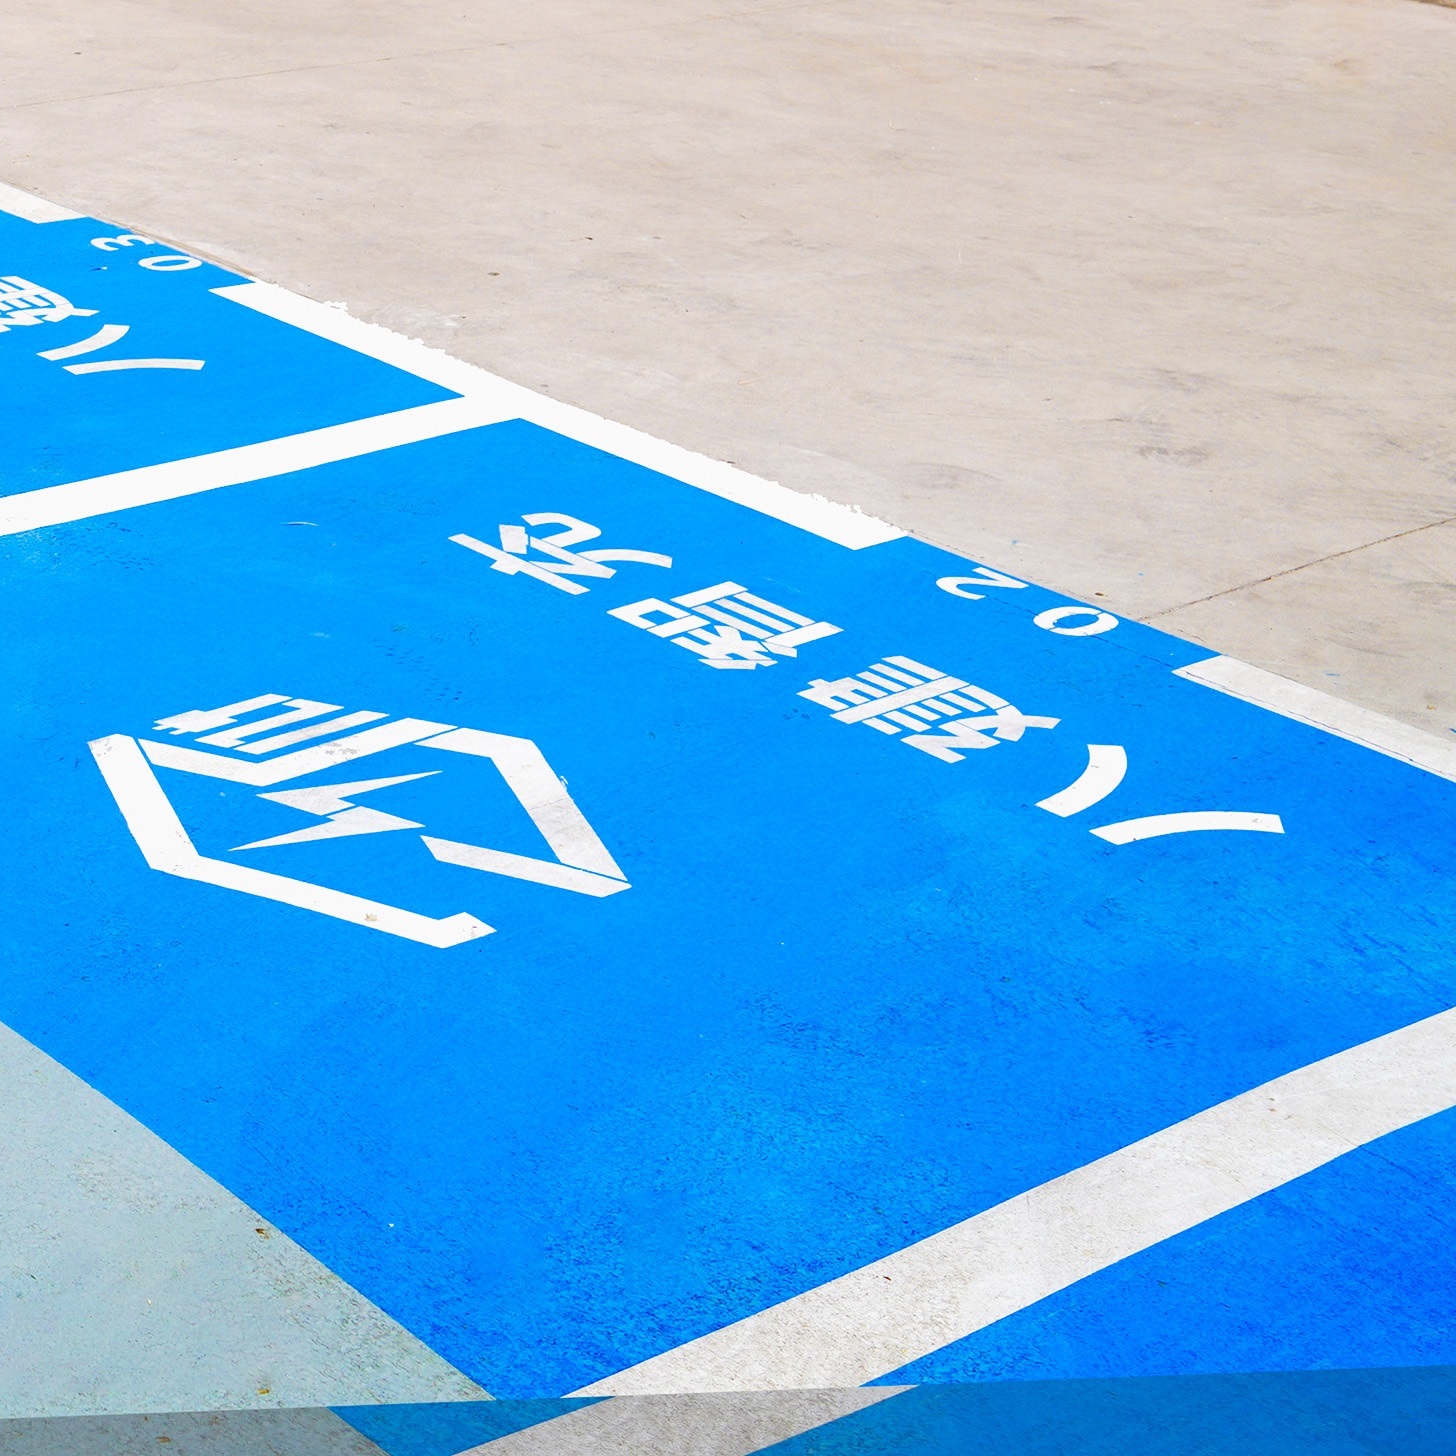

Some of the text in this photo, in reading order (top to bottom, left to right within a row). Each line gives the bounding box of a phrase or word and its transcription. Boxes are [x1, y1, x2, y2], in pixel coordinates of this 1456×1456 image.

[91, 234, 204, 272] 03
[936, 566, 1119, 636] 02
[448, 512, 1286, 847] 八建智充
